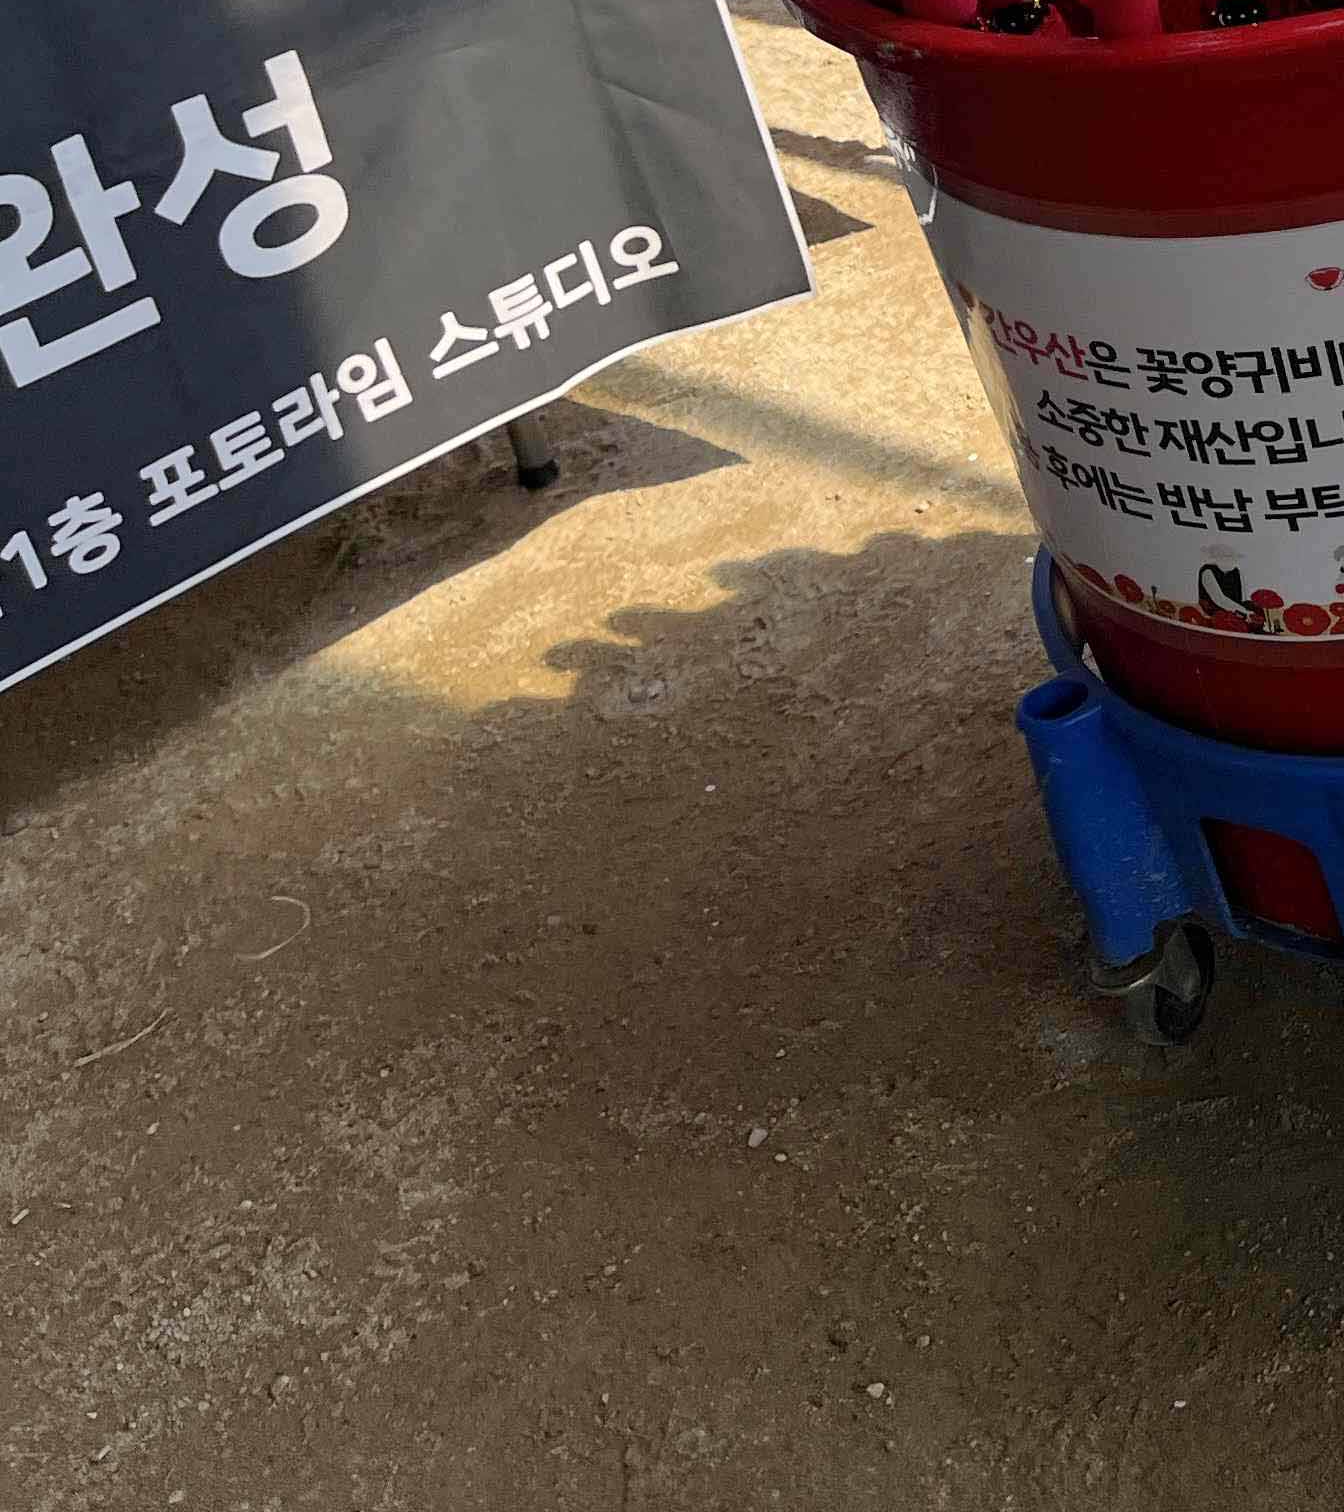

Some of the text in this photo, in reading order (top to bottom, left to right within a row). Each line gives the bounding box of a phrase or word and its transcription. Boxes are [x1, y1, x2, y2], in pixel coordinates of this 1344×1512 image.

[0, 48, 350, 388] 완성
[1, 224, 680, 591] 1층 포토라임 스튜디오
[1036, 389, 1151, 458] 소중한
[1041, 444, 1153, 520] 후에는
[1156, 481, 1254, 534] 반납
